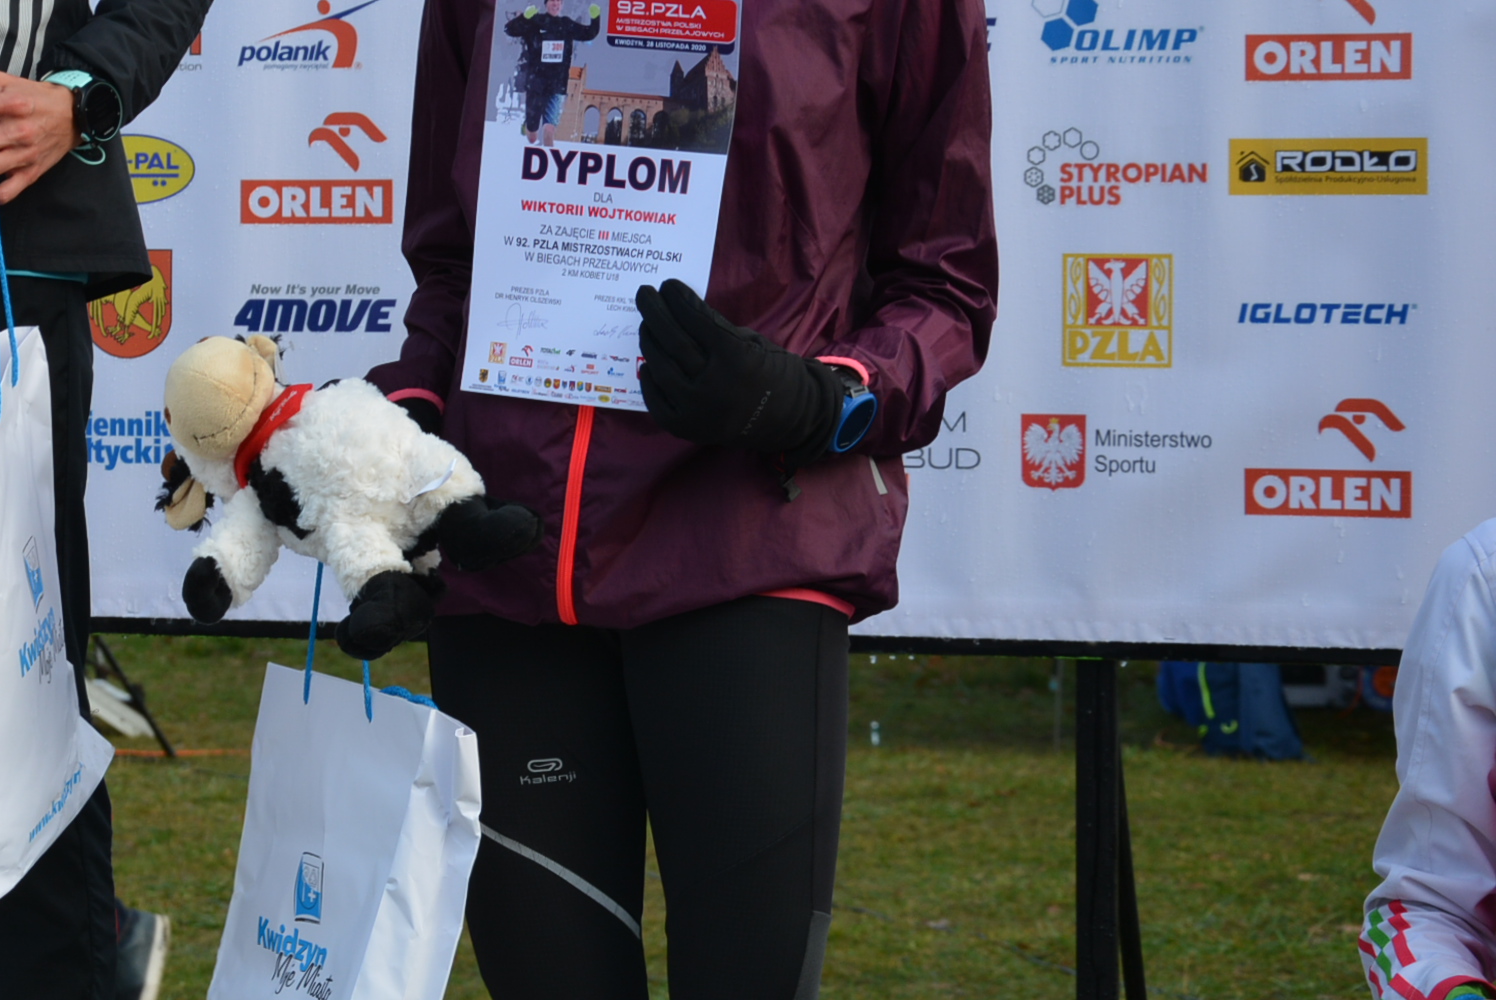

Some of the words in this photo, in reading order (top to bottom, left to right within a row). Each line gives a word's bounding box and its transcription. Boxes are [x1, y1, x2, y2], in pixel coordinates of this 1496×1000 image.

[617, 0, 707, 20] 92.PZLA
[1074, 28, 1198, 51] OLIMP
[237, 40, 332, 67] polanik
[1049, 55, 1099, 64] SPORT
[1107, 55, 1193, 64] NUTRITION
[1253, 39, 1402, 76] ORLEN
[521, 146, 692, 195] DYPLOM
[1058, 162, 1208, 184] STYROPIAN
[1275, 150, 1418, 173] RODŁO
[248, 185, 384, 218] ORLEN
[593, 192, 613, 204] DLA
[1058, 185, 1122, 207] PLUS
[521, 199, 585, 216] WIKTORII
[587, 206, 677, 225] WOJTKOWIAK
[611, 231, 653, 245] MIEJSCA
[515, 237, 531, 248] 92.
[533, 239, 559, 251] PZLA
[561, 241, 644, 259] MISTRZOSTWACH
[645, 249, 683, 263] POLSKI
[536, 253, 581, 267] BIEGACH
[250, 283, 282, 296] Now
[284, 283, 307, 296] It's
[310, 285, 341, 297] your
[345, 283, 380, 296] Move
[1237, 302, 1410, 325] IGLOTECH
[1068, 330, 1166, 362] PZLA
[86, 410, 171, 437] iennik
[1094, 428, 1213, 449] Ministerstwo
[1094, 454, 1157, 476] Sportu
[1253, 474, 1402, 512] ORLEN
[519, 771, 577, 786] Kalenji
[257, 915, 328, 973] Kwidzyn
[271, 951, 296, 994] Mje
